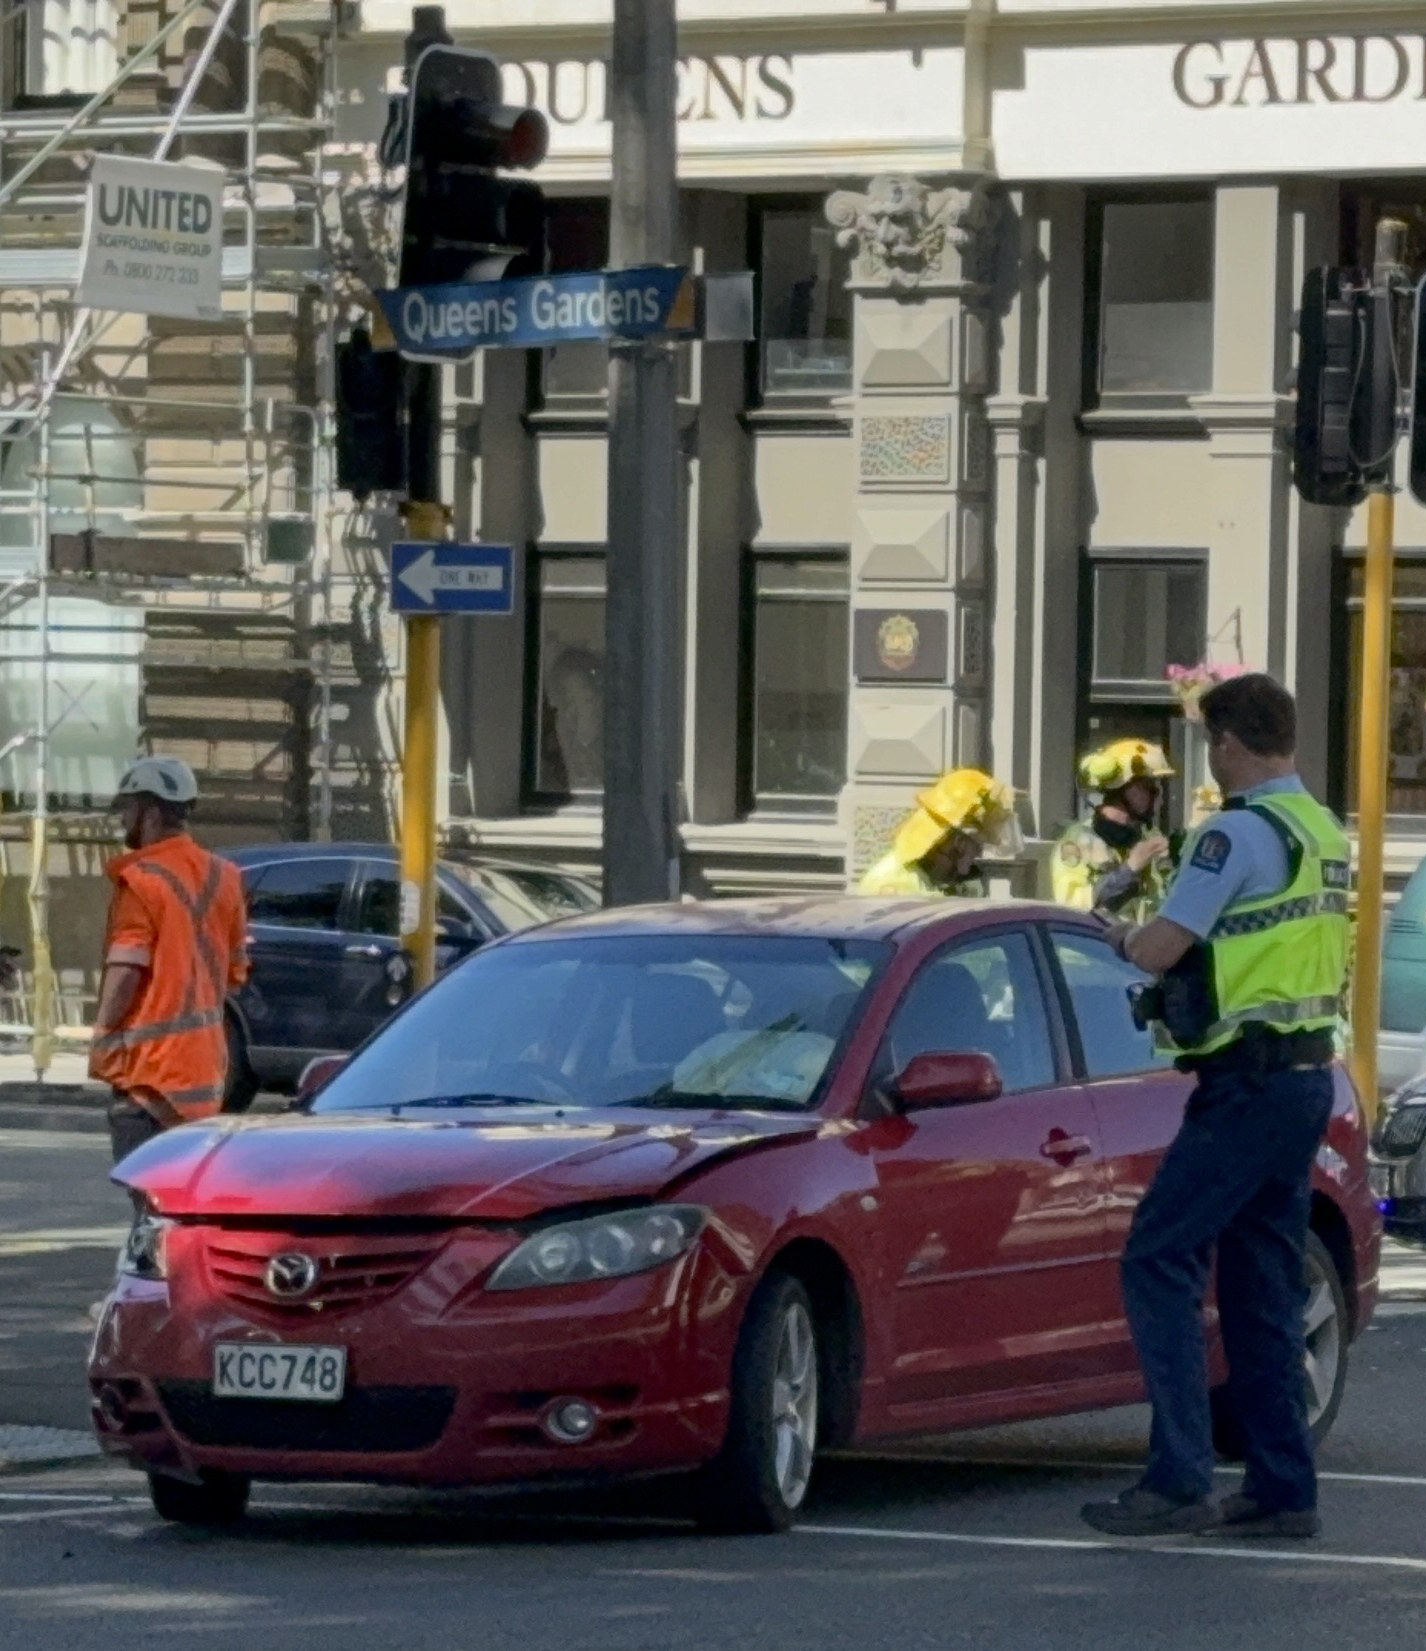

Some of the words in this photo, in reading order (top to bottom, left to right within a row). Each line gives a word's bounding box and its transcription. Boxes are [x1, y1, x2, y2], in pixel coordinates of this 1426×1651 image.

[100, 183, 212, 234] UNITED
[172, 241, 212, 258] GROUP
[403, 291, 518, 344] Queens
[531, 280, 660, 331] Gardens
[219, 1352, 338, 1392] KCC748
